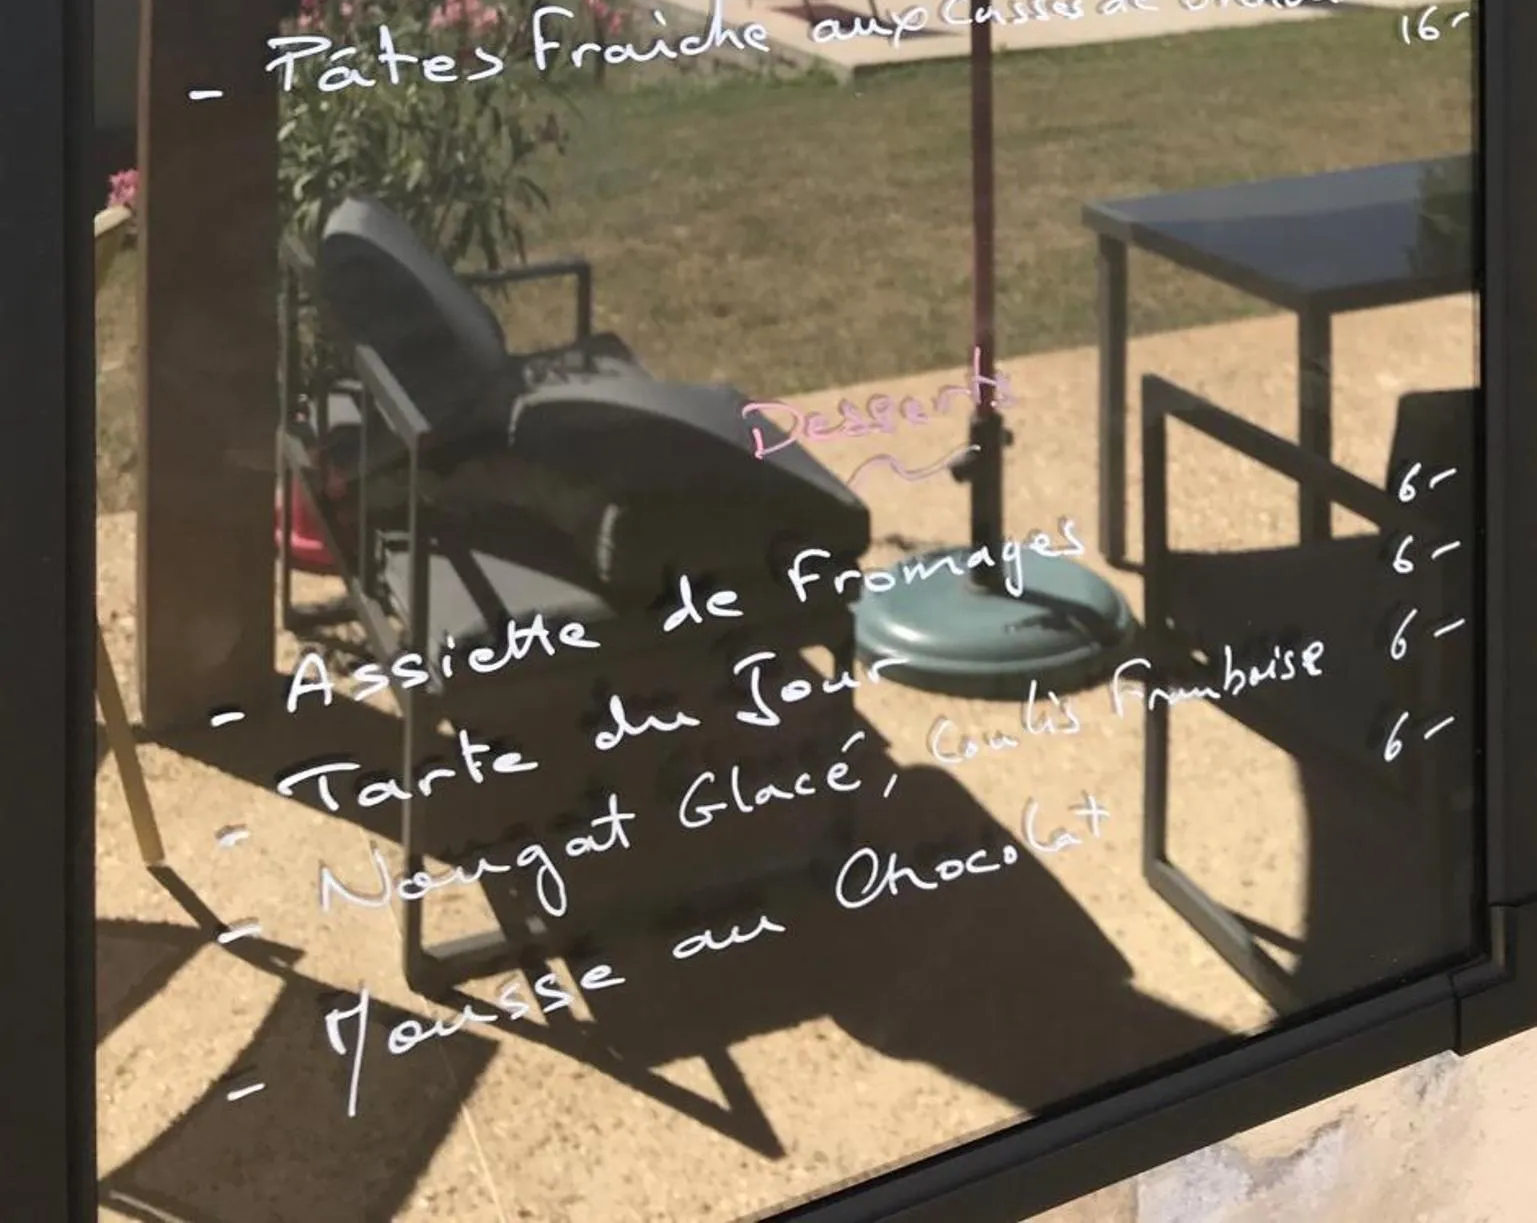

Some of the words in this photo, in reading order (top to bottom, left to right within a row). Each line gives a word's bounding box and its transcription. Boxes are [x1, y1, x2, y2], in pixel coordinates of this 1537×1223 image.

[812, 2, 928, 46] aux
[285, 613, 600, 714] Assiette
[662, 574, 744, 633] de
[787, 518, 1087, 598] Fromages
[276, 729, 539, 813] Tarte
[595, 698, 700, 752] du
[732, 651, 914, 727] Jour
[319, 793, 637, 915] Nougat
[324, 960, 627, 1118] Mousse
[673, 913, 787, 961] au
